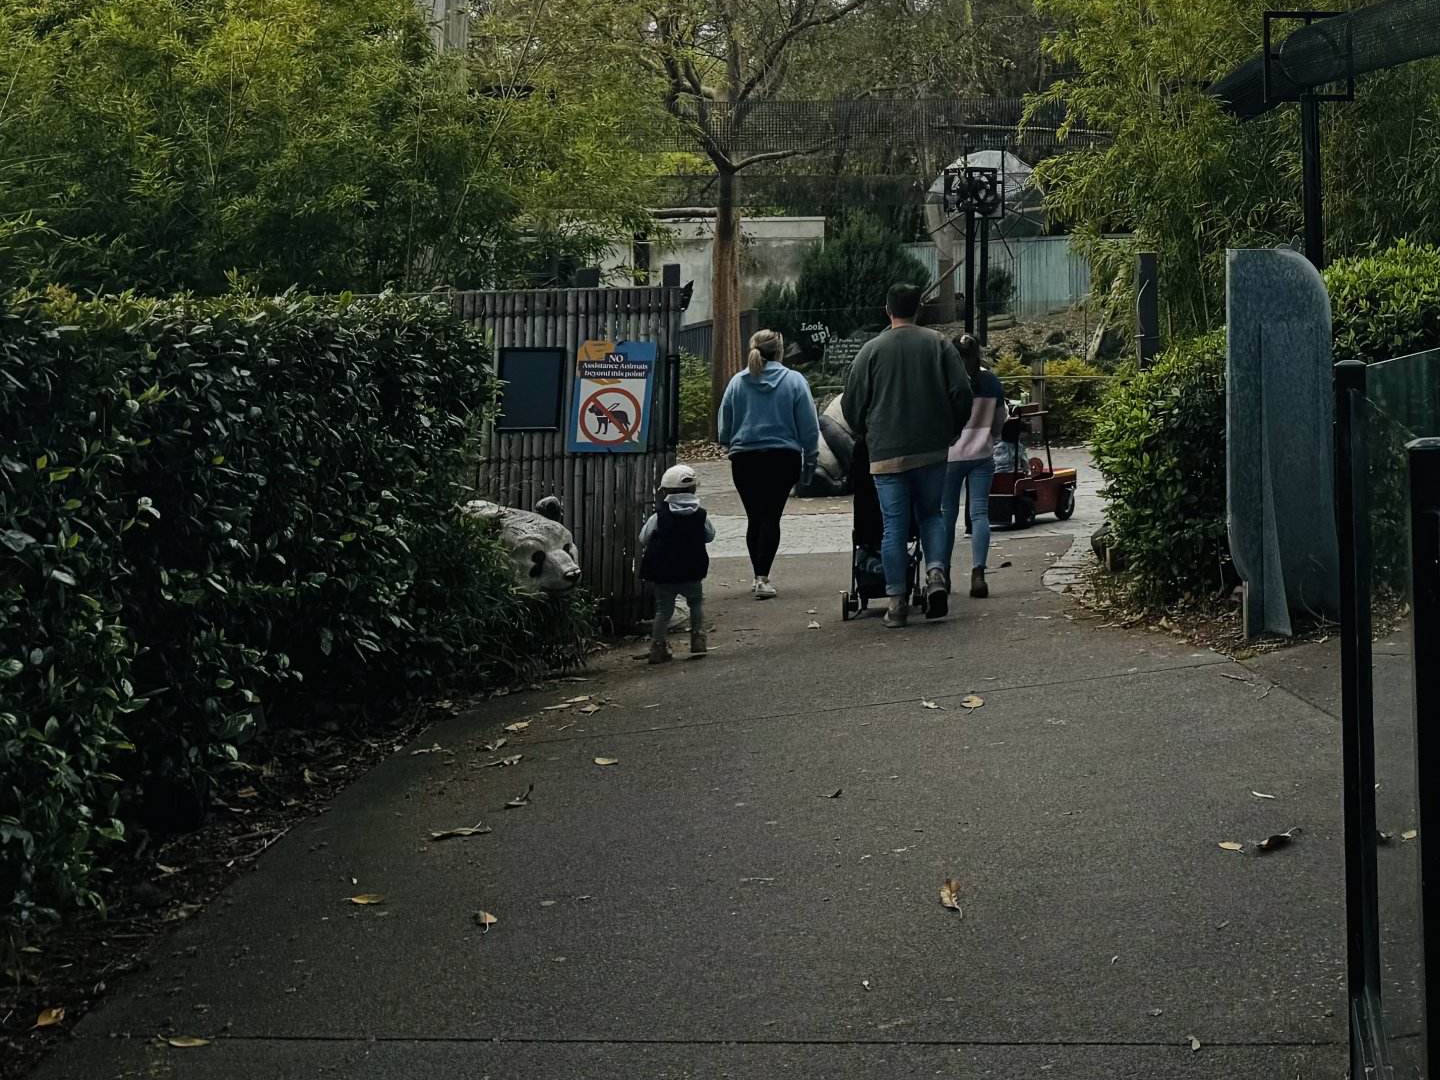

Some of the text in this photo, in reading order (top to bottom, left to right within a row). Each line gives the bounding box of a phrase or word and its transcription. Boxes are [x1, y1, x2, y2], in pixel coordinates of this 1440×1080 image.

[800, 321, 824, 332] Look
[810, 326, 831, 344] up!
[608, 354, 624, 363] NO
[582, 362, 619, 370] Assistance
[584, 370, 611, 378] beyond
